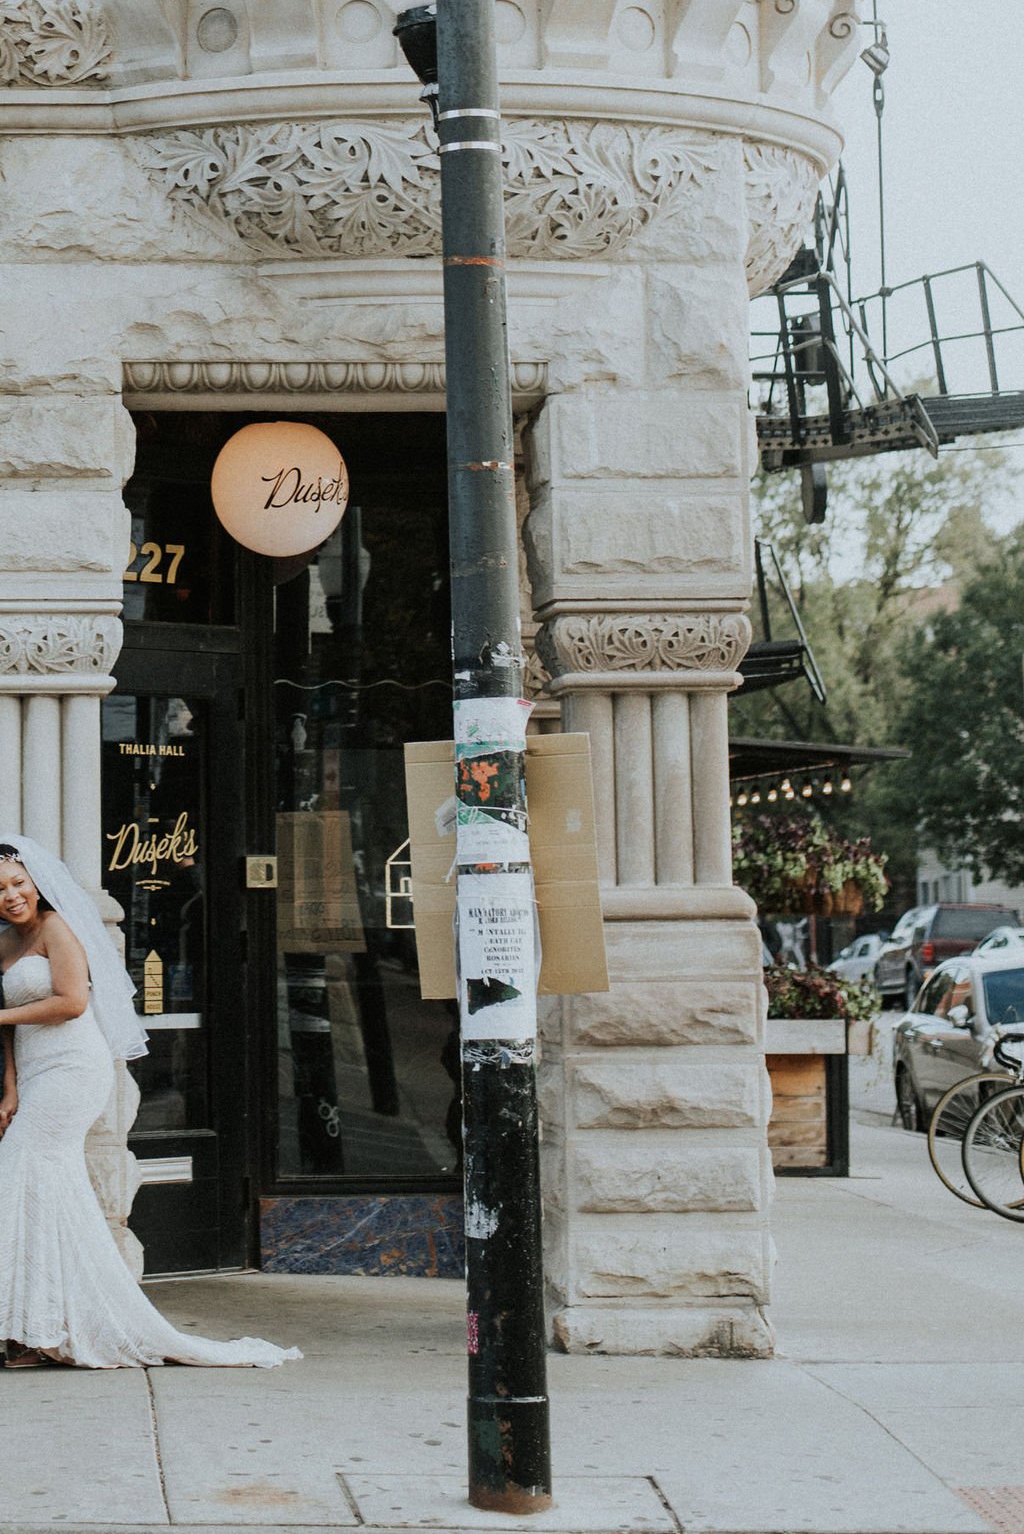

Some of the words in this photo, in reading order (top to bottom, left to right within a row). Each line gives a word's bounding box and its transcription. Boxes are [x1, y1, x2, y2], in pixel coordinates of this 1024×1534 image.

[119, 743, 157, 756] THALIA
[159, 745, 186, 757] HALL
[106, 811, 199, 876] Dusek's
